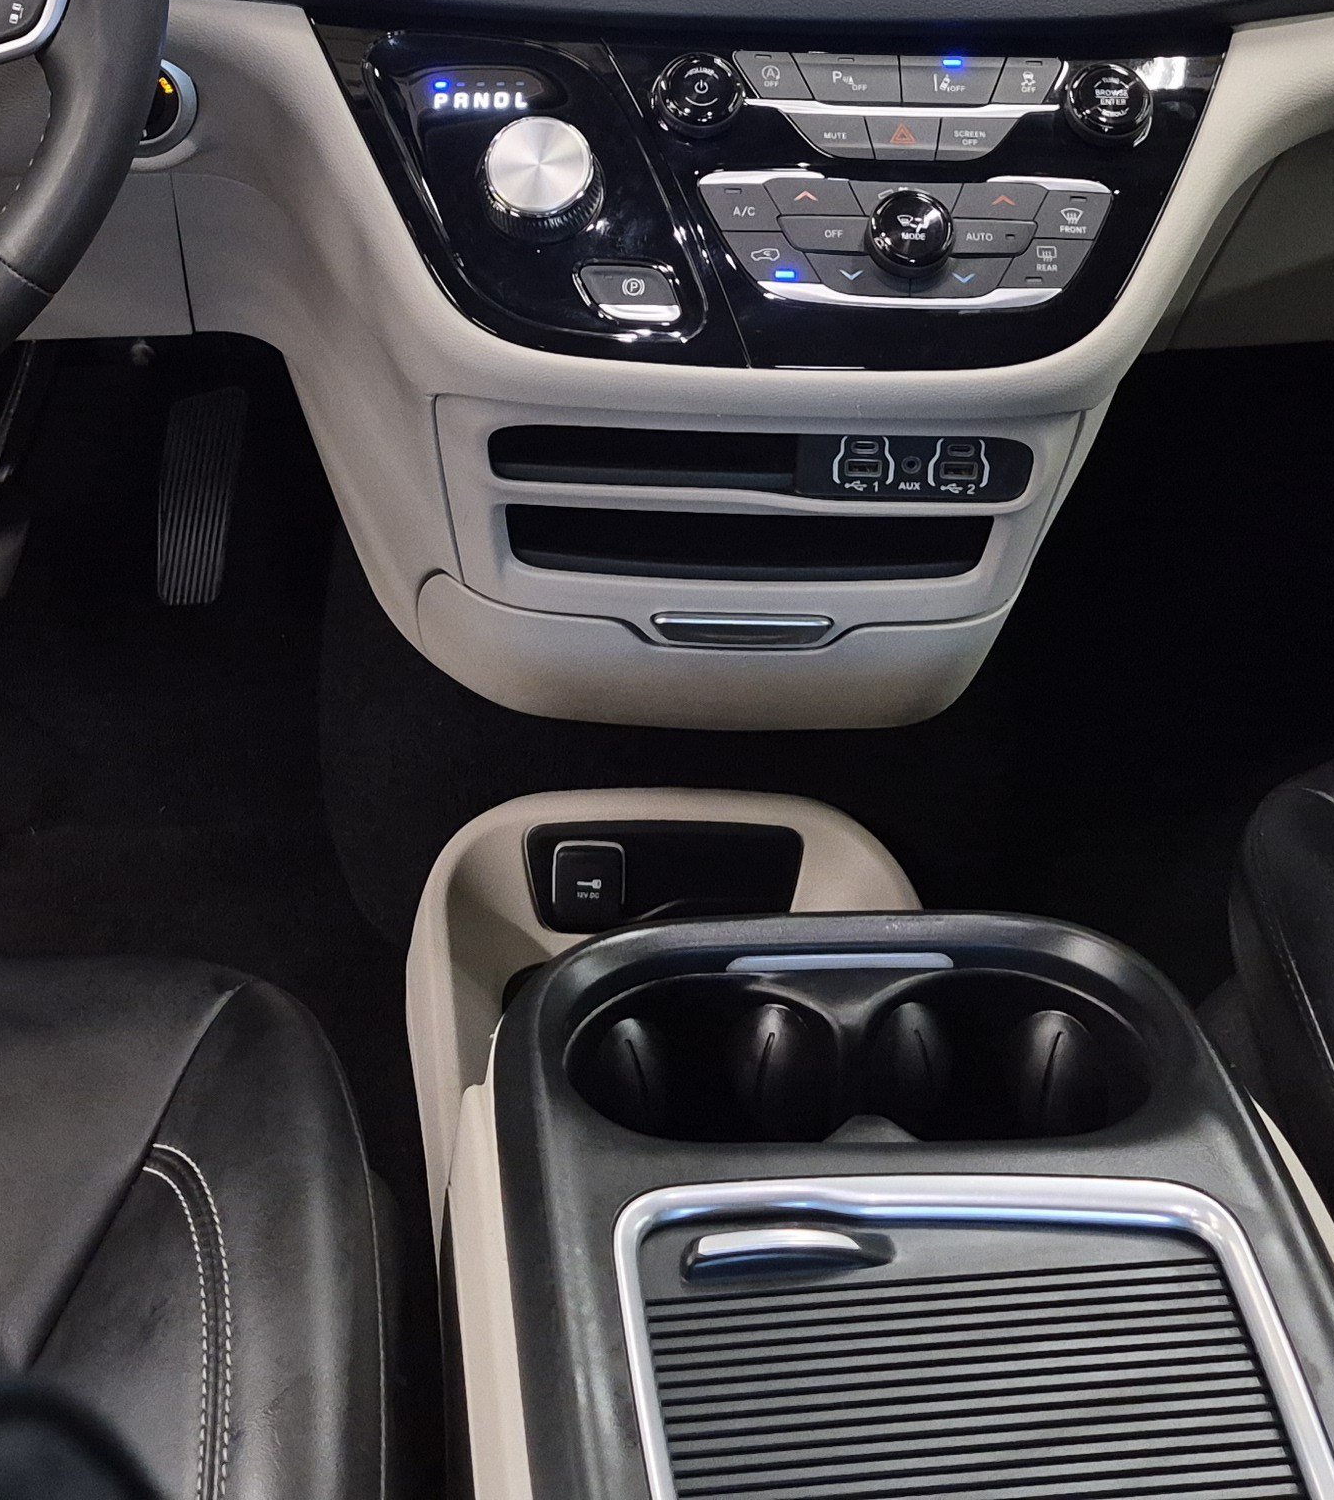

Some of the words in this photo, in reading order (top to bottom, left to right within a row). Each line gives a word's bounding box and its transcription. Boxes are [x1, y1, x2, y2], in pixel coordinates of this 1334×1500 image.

[950, 84, 966, 92] OFF
[1094, 88, 1129, 97] BROWSE
[823, 131, 847, 140] MUTE
[953, 130, 986, 139] SCREEN
[961, 138, 978, 147] OFF
[732, 206, 756, 217] A/C
[824, 229, 844, 238] OFF
[1059, 225, 1087, 234] FRONT
[900, 232, 926, 241] MODE
[965, 232, 993, 242] AUTO
[1036, 263, 1058, 272] REAR
[898, 481, 921, 491] AUX
[967, 484, 975, 495] 2
[576, 891, 589, 899] 12V
